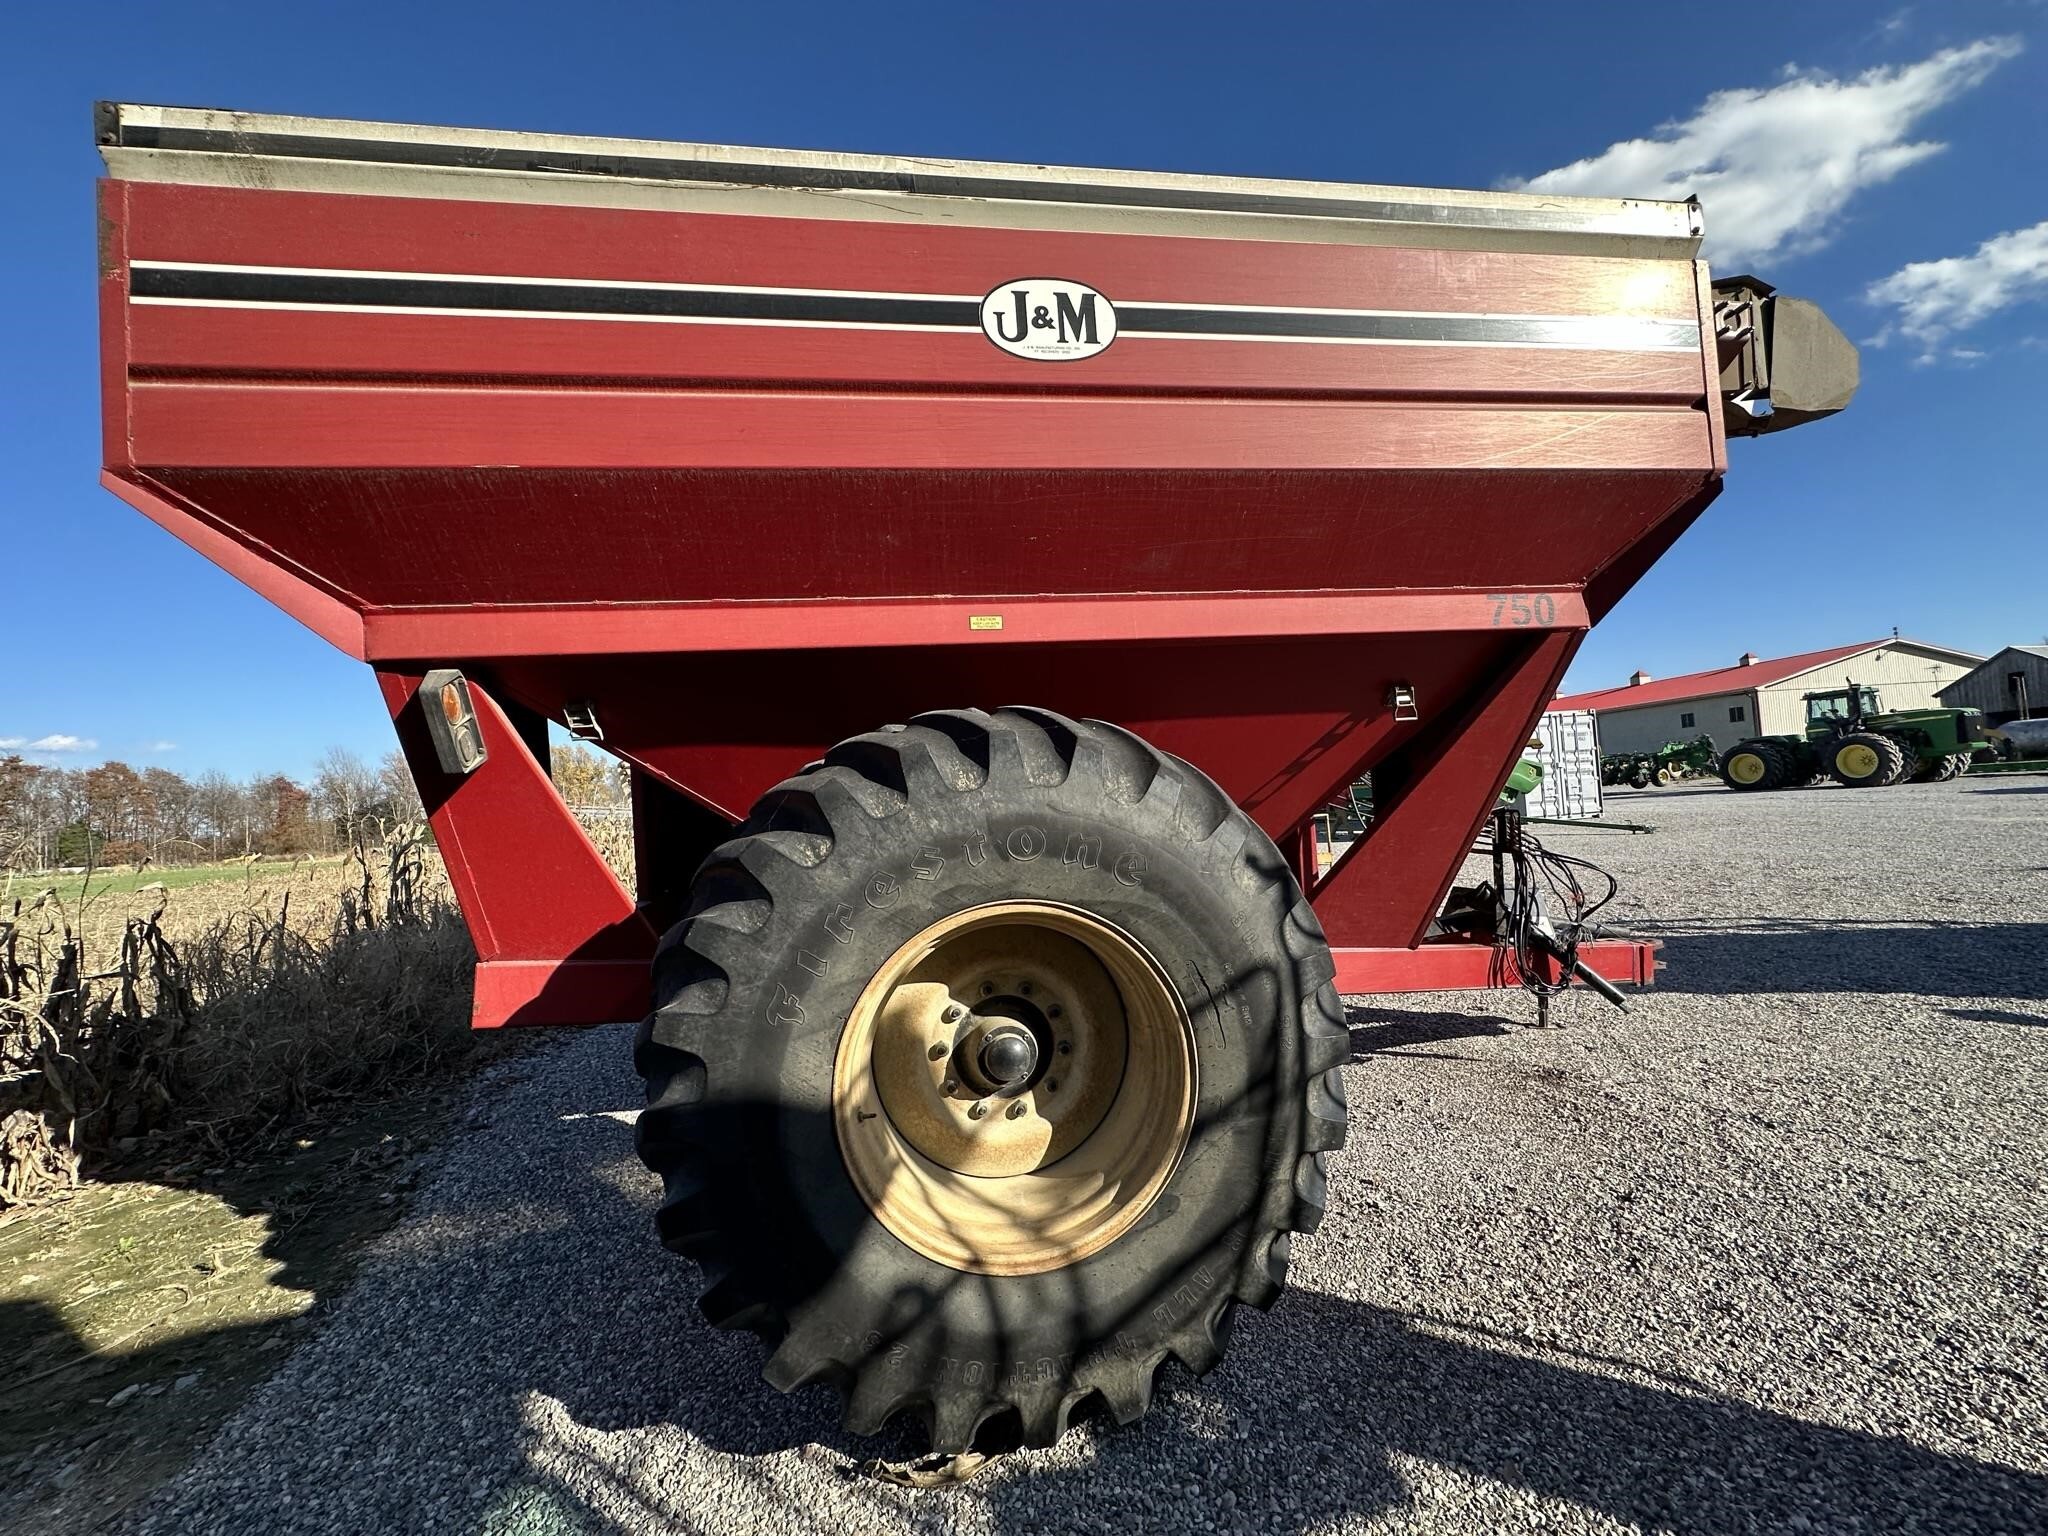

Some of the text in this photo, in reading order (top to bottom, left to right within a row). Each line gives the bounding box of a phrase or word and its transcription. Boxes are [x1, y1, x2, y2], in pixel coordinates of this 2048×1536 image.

[993, 290, 1101, 345] J&M
[1487, 593, 1555, 627] 750
[766, 825, 1149, 1026] Firestone
[1153, 1266, 1215, 1323] ALL
